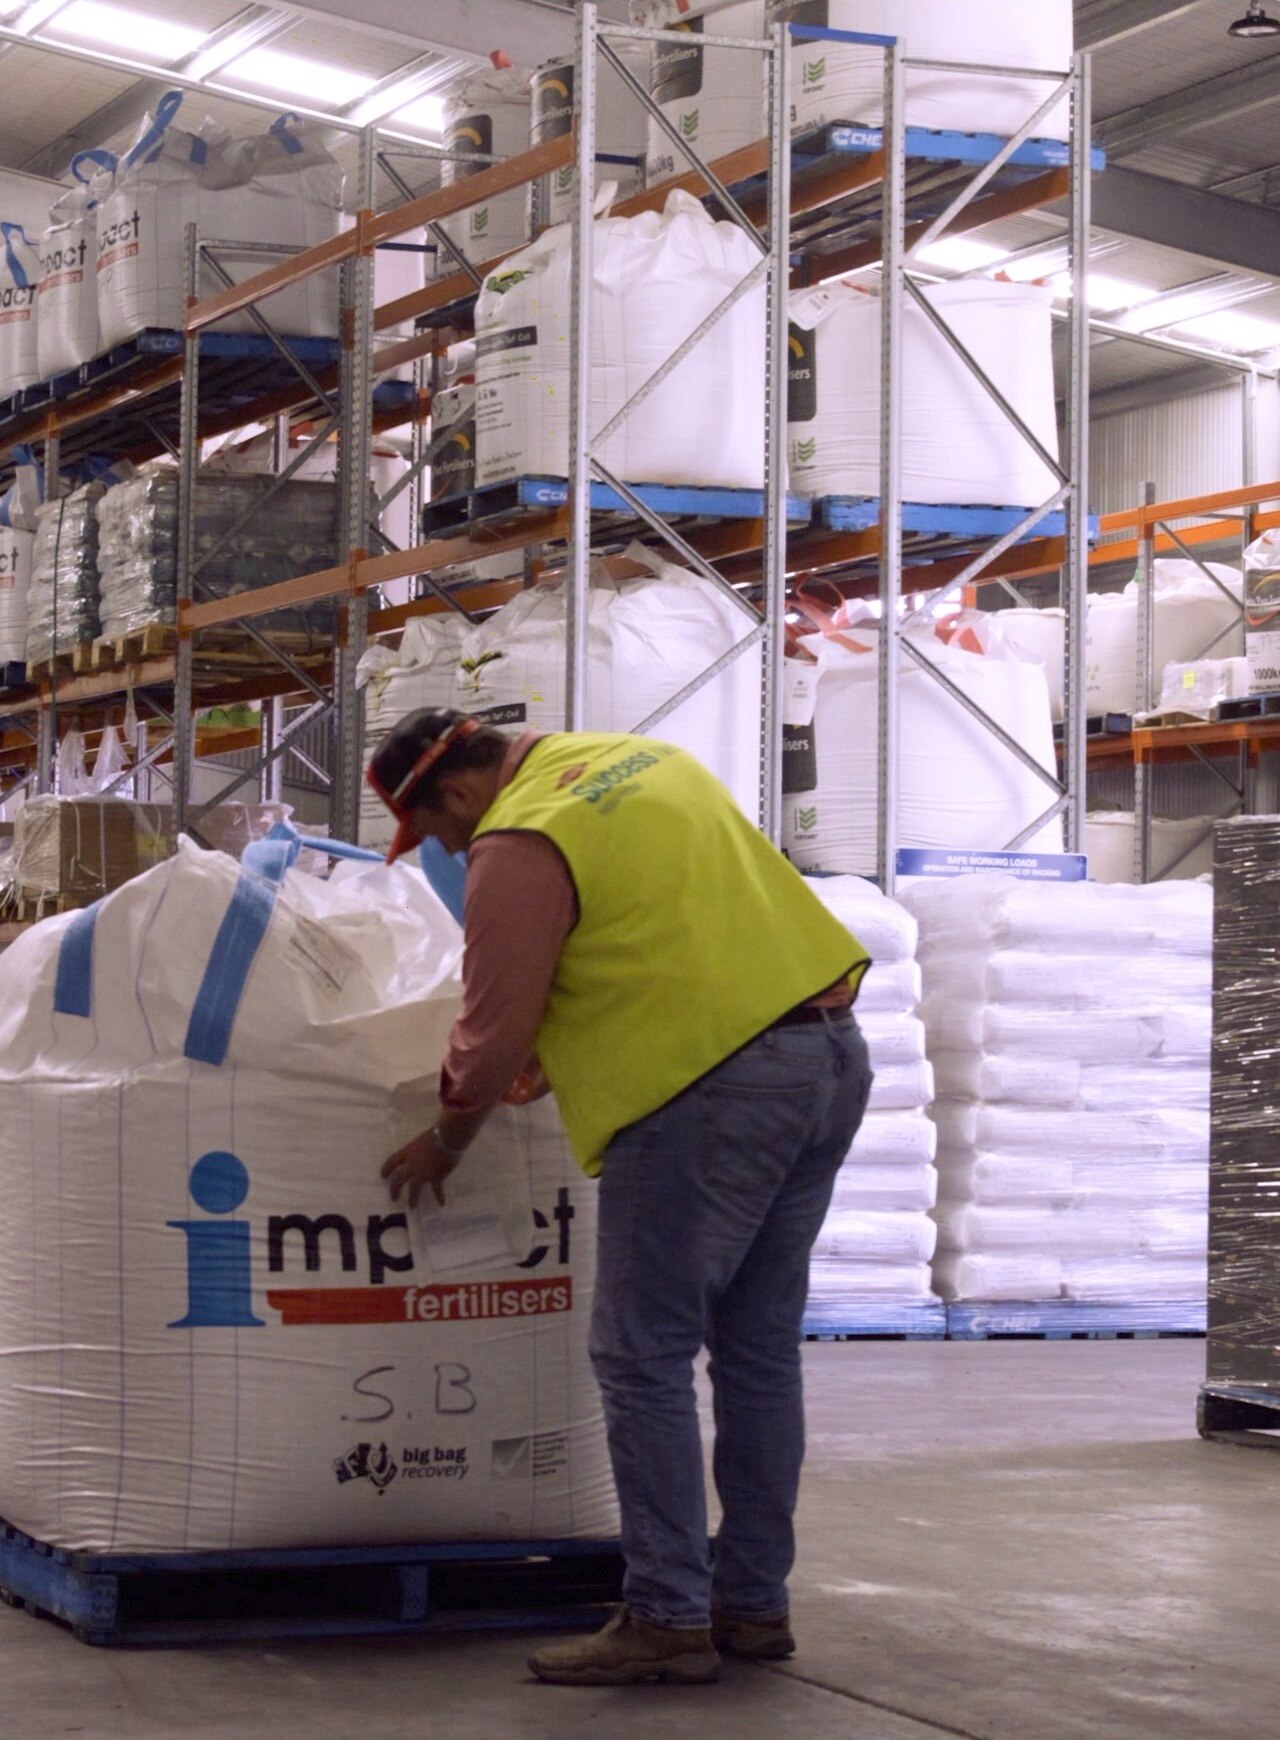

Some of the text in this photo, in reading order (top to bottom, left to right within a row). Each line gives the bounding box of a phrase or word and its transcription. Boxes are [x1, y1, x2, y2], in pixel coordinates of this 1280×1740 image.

[946, 855, 1038, 868] SAFE WORKING LOADS
[166, 1150, 575, 1327] impt
[402, 1283, 569, 1321] fertilisers
[403, 1446, 467, 1466] big bag
[401, 1463, 470, 1481] recovery
